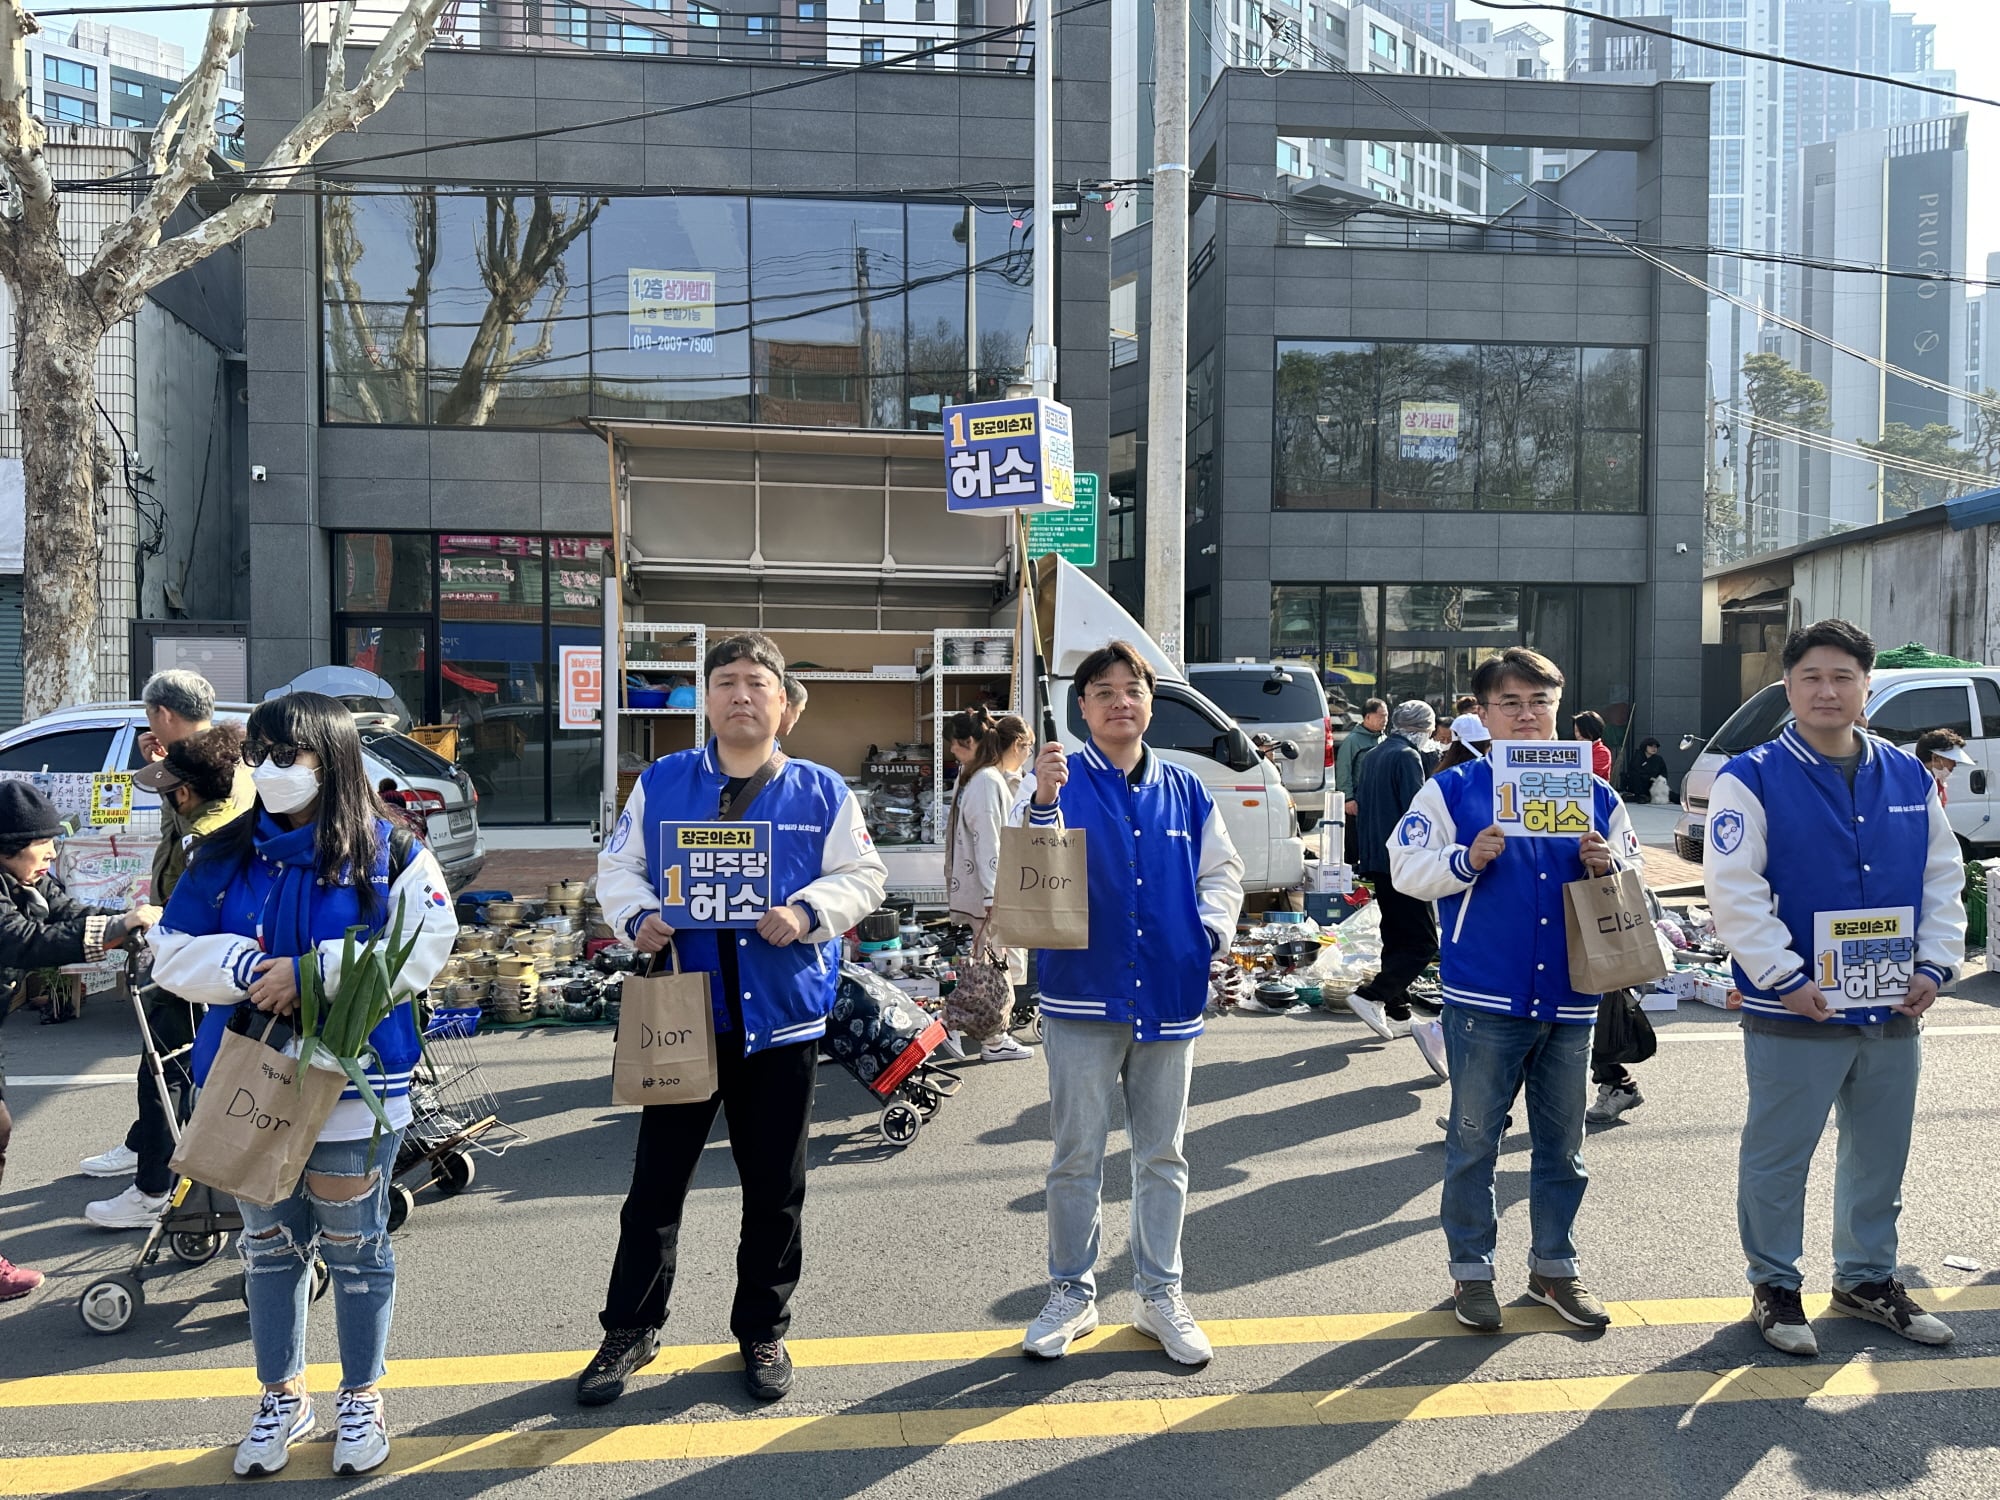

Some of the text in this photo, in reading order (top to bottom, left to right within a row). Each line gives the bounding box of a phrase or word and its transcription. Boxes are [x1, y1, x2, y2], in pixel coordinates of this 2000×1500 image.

[1916, 192, 1939, 300] PRUGO
[633, 278, 711, 302] 1,2층 상가임대
[633, 334, 713, 353] 010-2009-7500
[949, 412, 967, 448] 1
[972, 416, 1033, 437] 장군의손자
[1404, 411, 1454, 429] 상가임대
[949, 446, 1037, 500] 허소
[870, 764, 920, 776] sunrise
[1511, 750, 1577, 764] 새로운선택
[1520, 772, 1592, 798] 유능한
[1496, 782, 1520, 823] 1
[1523, 800, 1590, 833] 허소
[681, 830, 751, 846] 장군의손자
[689, 851, 768, 878] 민주당
[663, 864, 686, 907] 1
[1019, 866, 1072, 892] Dior
[689, 882, 767, 922] 허소
[1597, 911, 1645, 934] 디올
[1834, 919, 1897, 936] 장군의손자
[1842, 937, 1914, 966] 민주당
[1818, 949, 1842, 992] 1
[1844, 963, 1911, 1000] 허소
[641, 1022, 693, 1049] Dior
[225, 1087, 291, 1131] Dior
